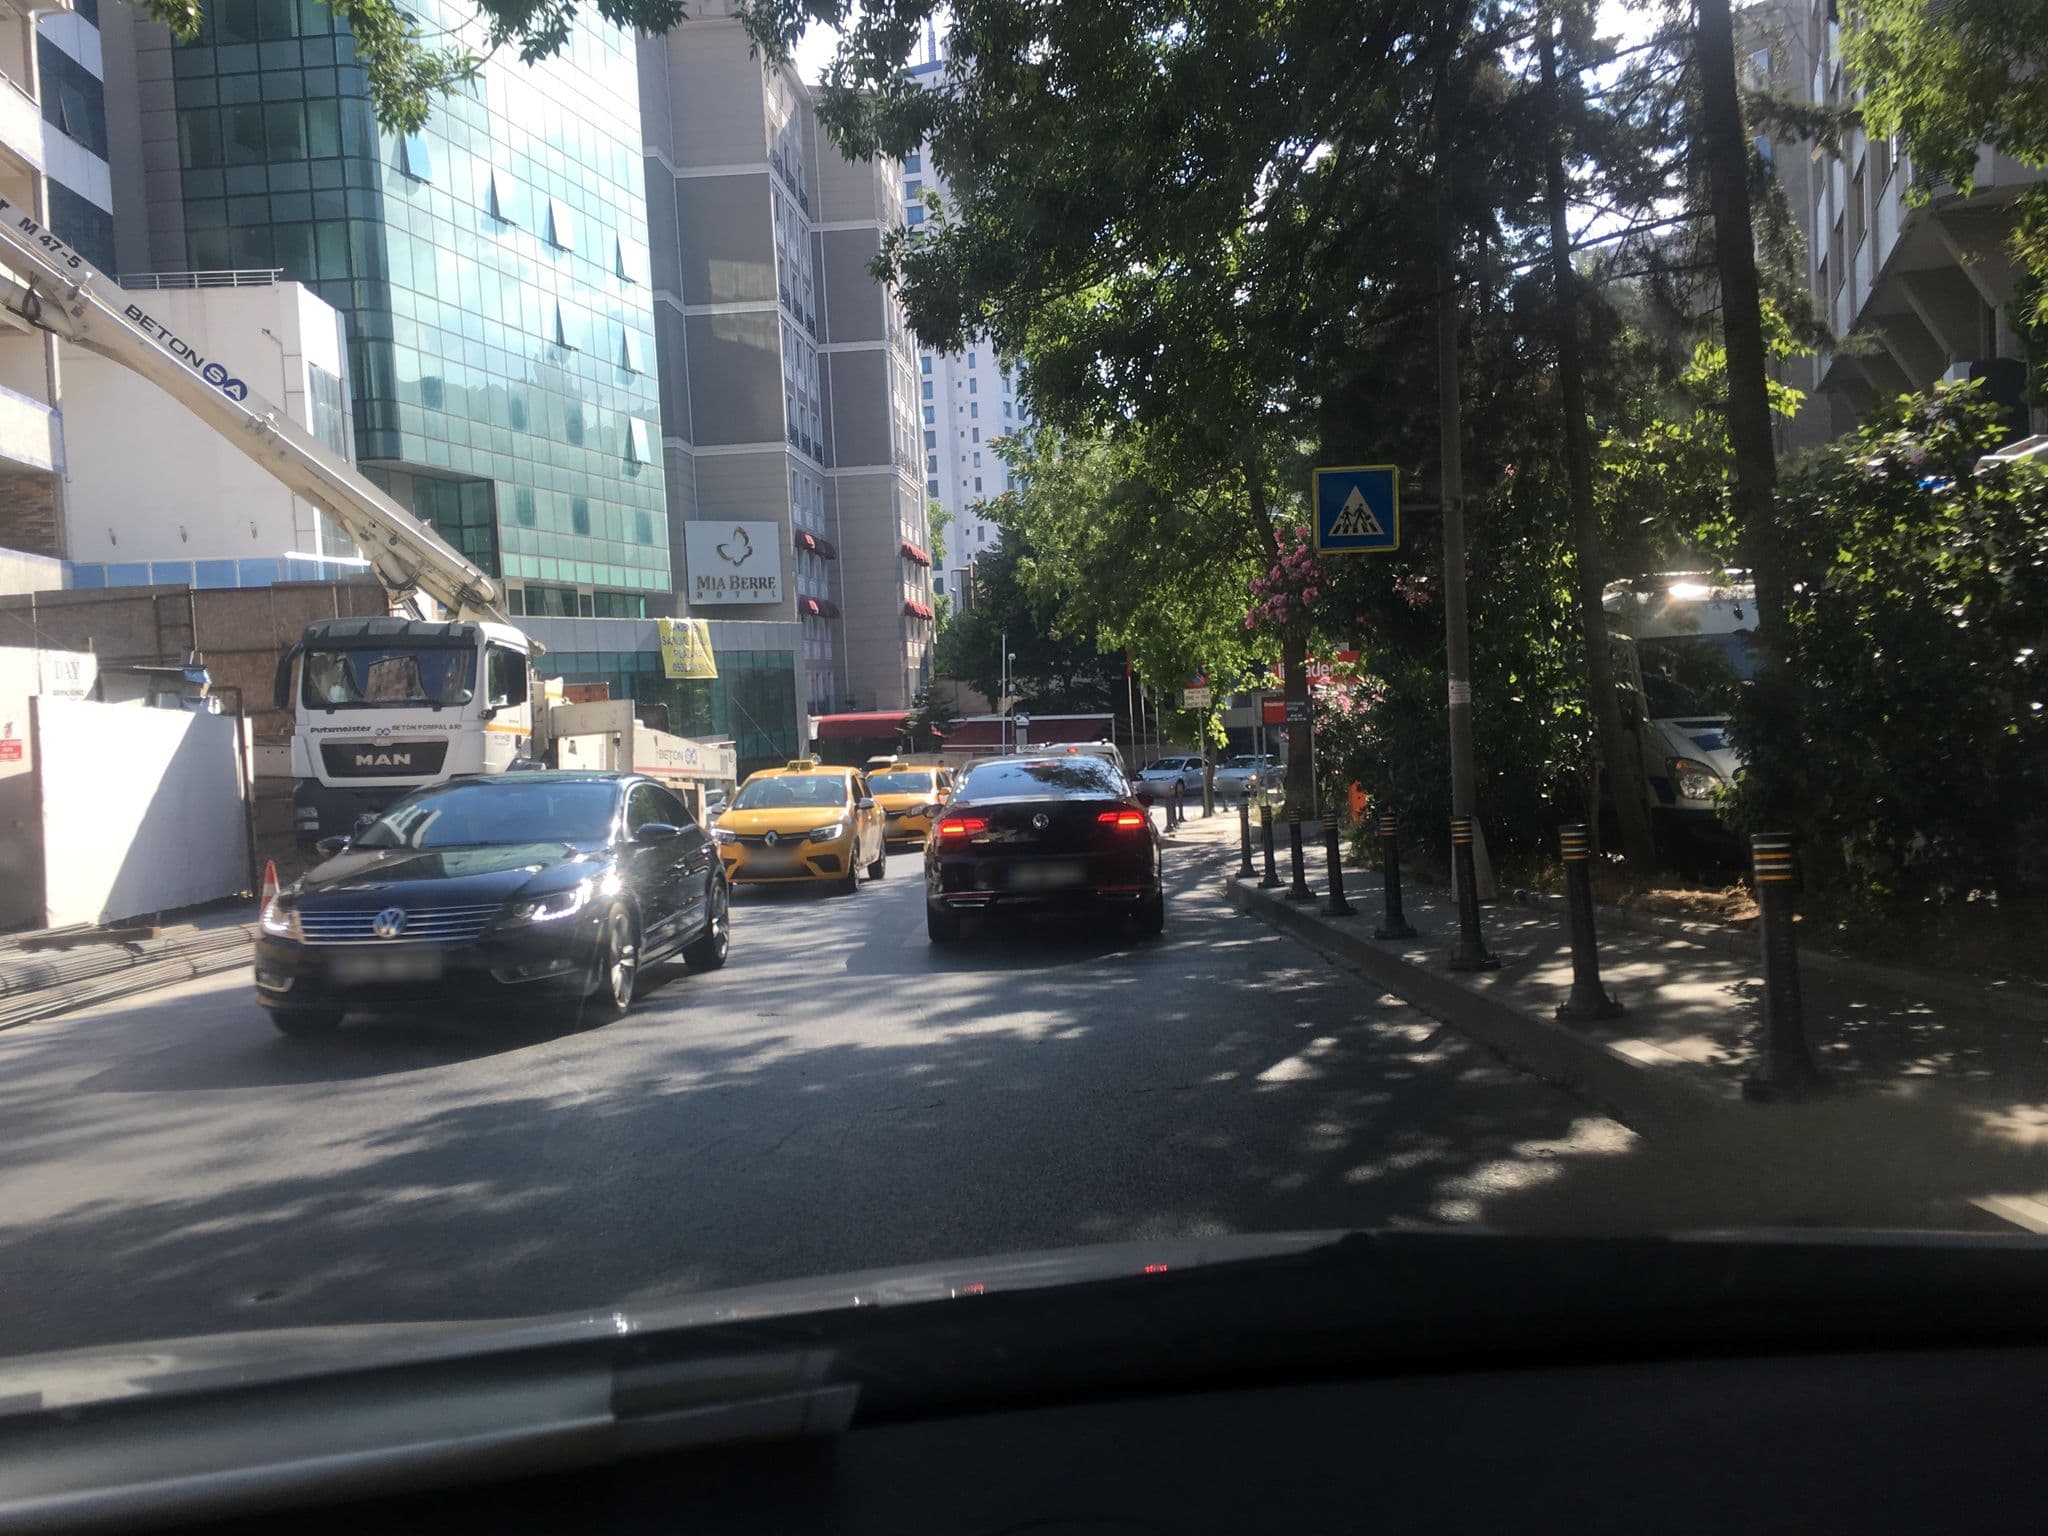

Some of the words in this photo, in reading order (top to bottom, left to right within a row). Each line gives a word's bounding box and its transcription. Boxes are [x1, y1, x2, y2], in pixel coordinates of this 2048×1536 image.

[18, 216, 39, 236] M
[39, 235, 83, 269] 47-5
[123, 303, 248, 401] BETONSA
[696, 575, 726, 590] MIA
[729, 575, 776, 590] BERRE
[355, 753, 411, 766] MAN
